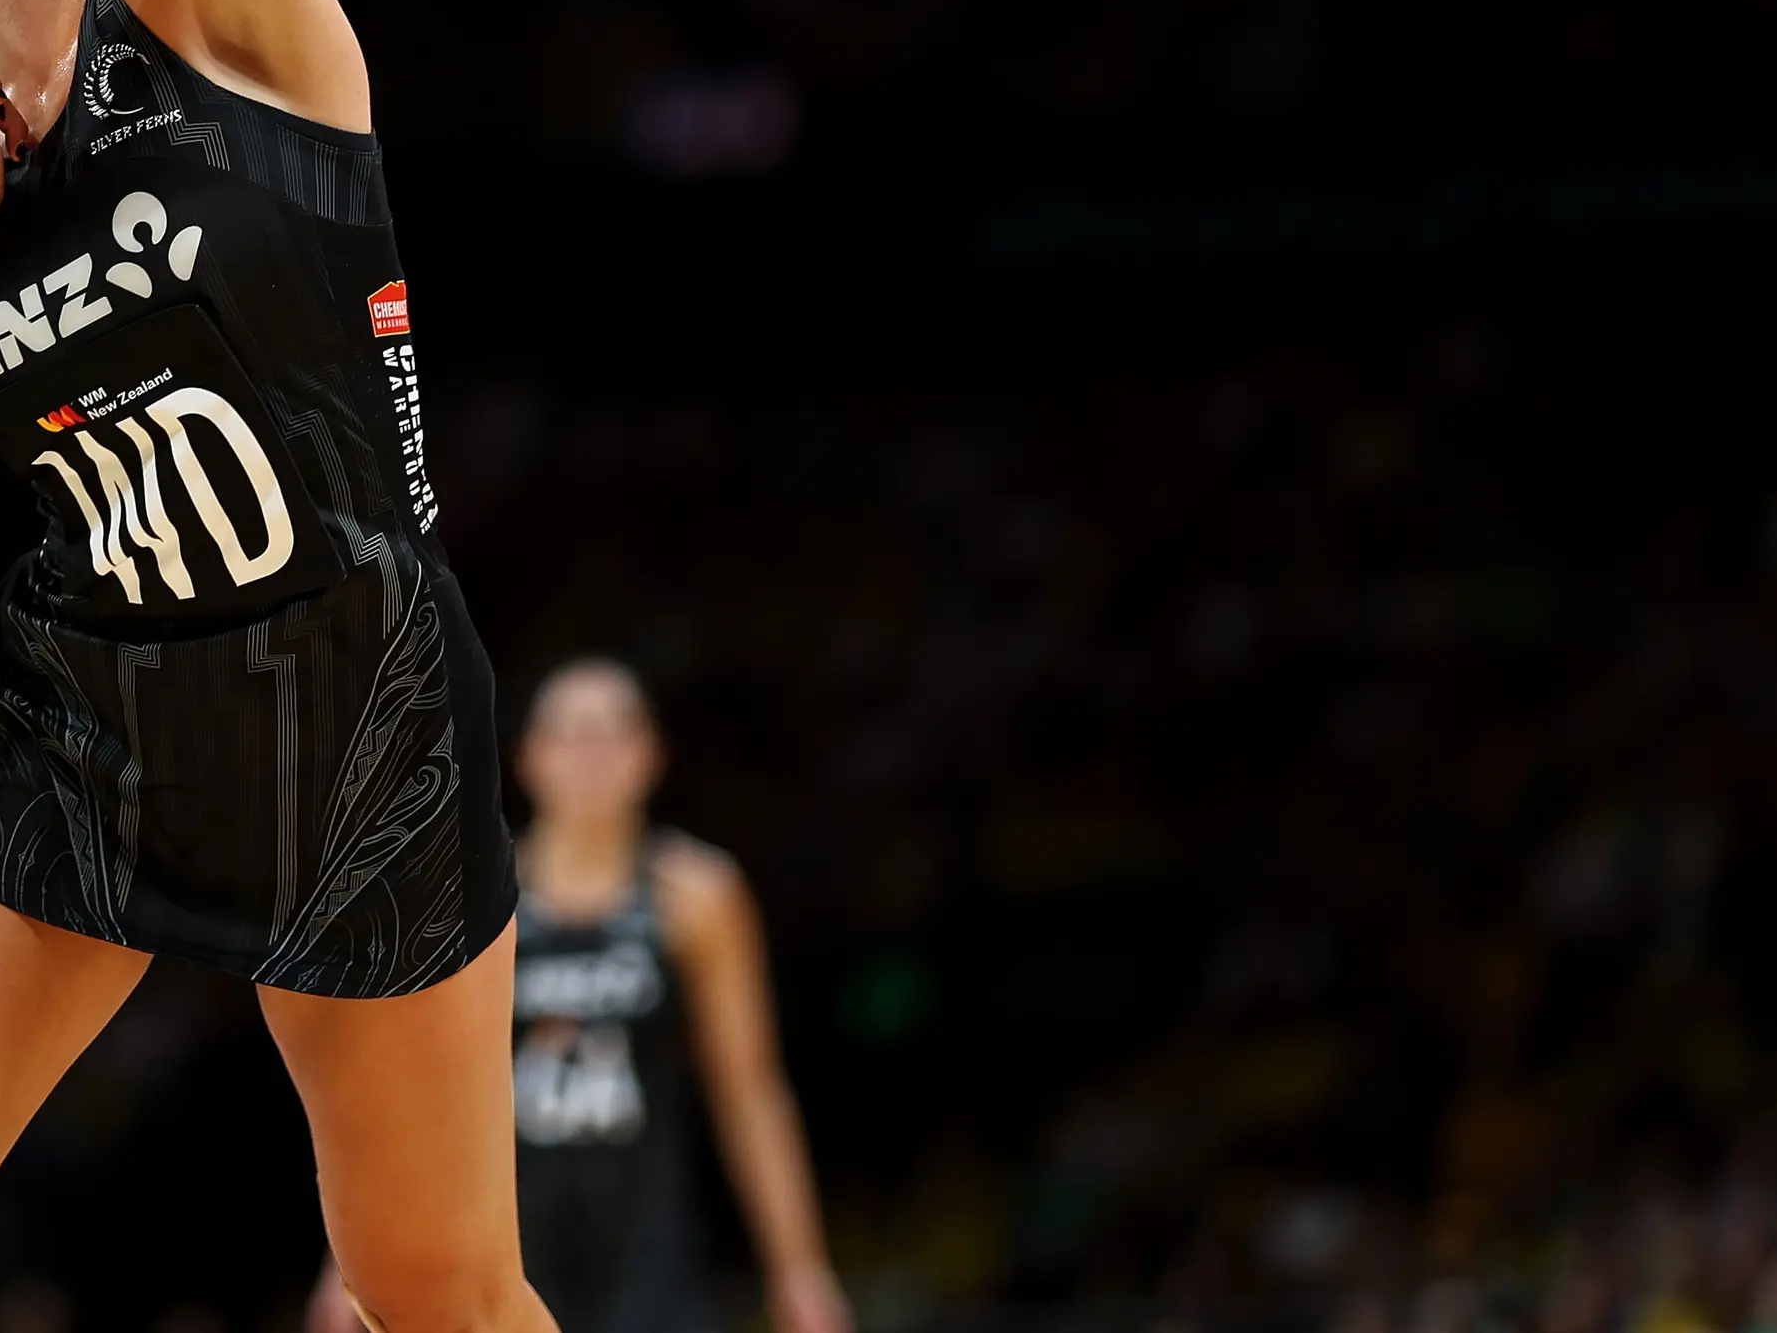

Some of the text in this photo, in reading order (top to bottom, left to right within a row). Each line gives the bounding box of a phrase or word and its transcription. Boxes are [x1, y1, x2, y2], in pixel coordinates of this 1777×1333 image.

[90, 109, 183, 155] SILVER FERNS
[78, 386, 107, 408] WM
[86, 367, 173, 420] New Zealand
[382, 346, 431, 535] WAREHOUSE
[399, 344, 439, 525] CHEM
[31, 387, 294, 604] WD
